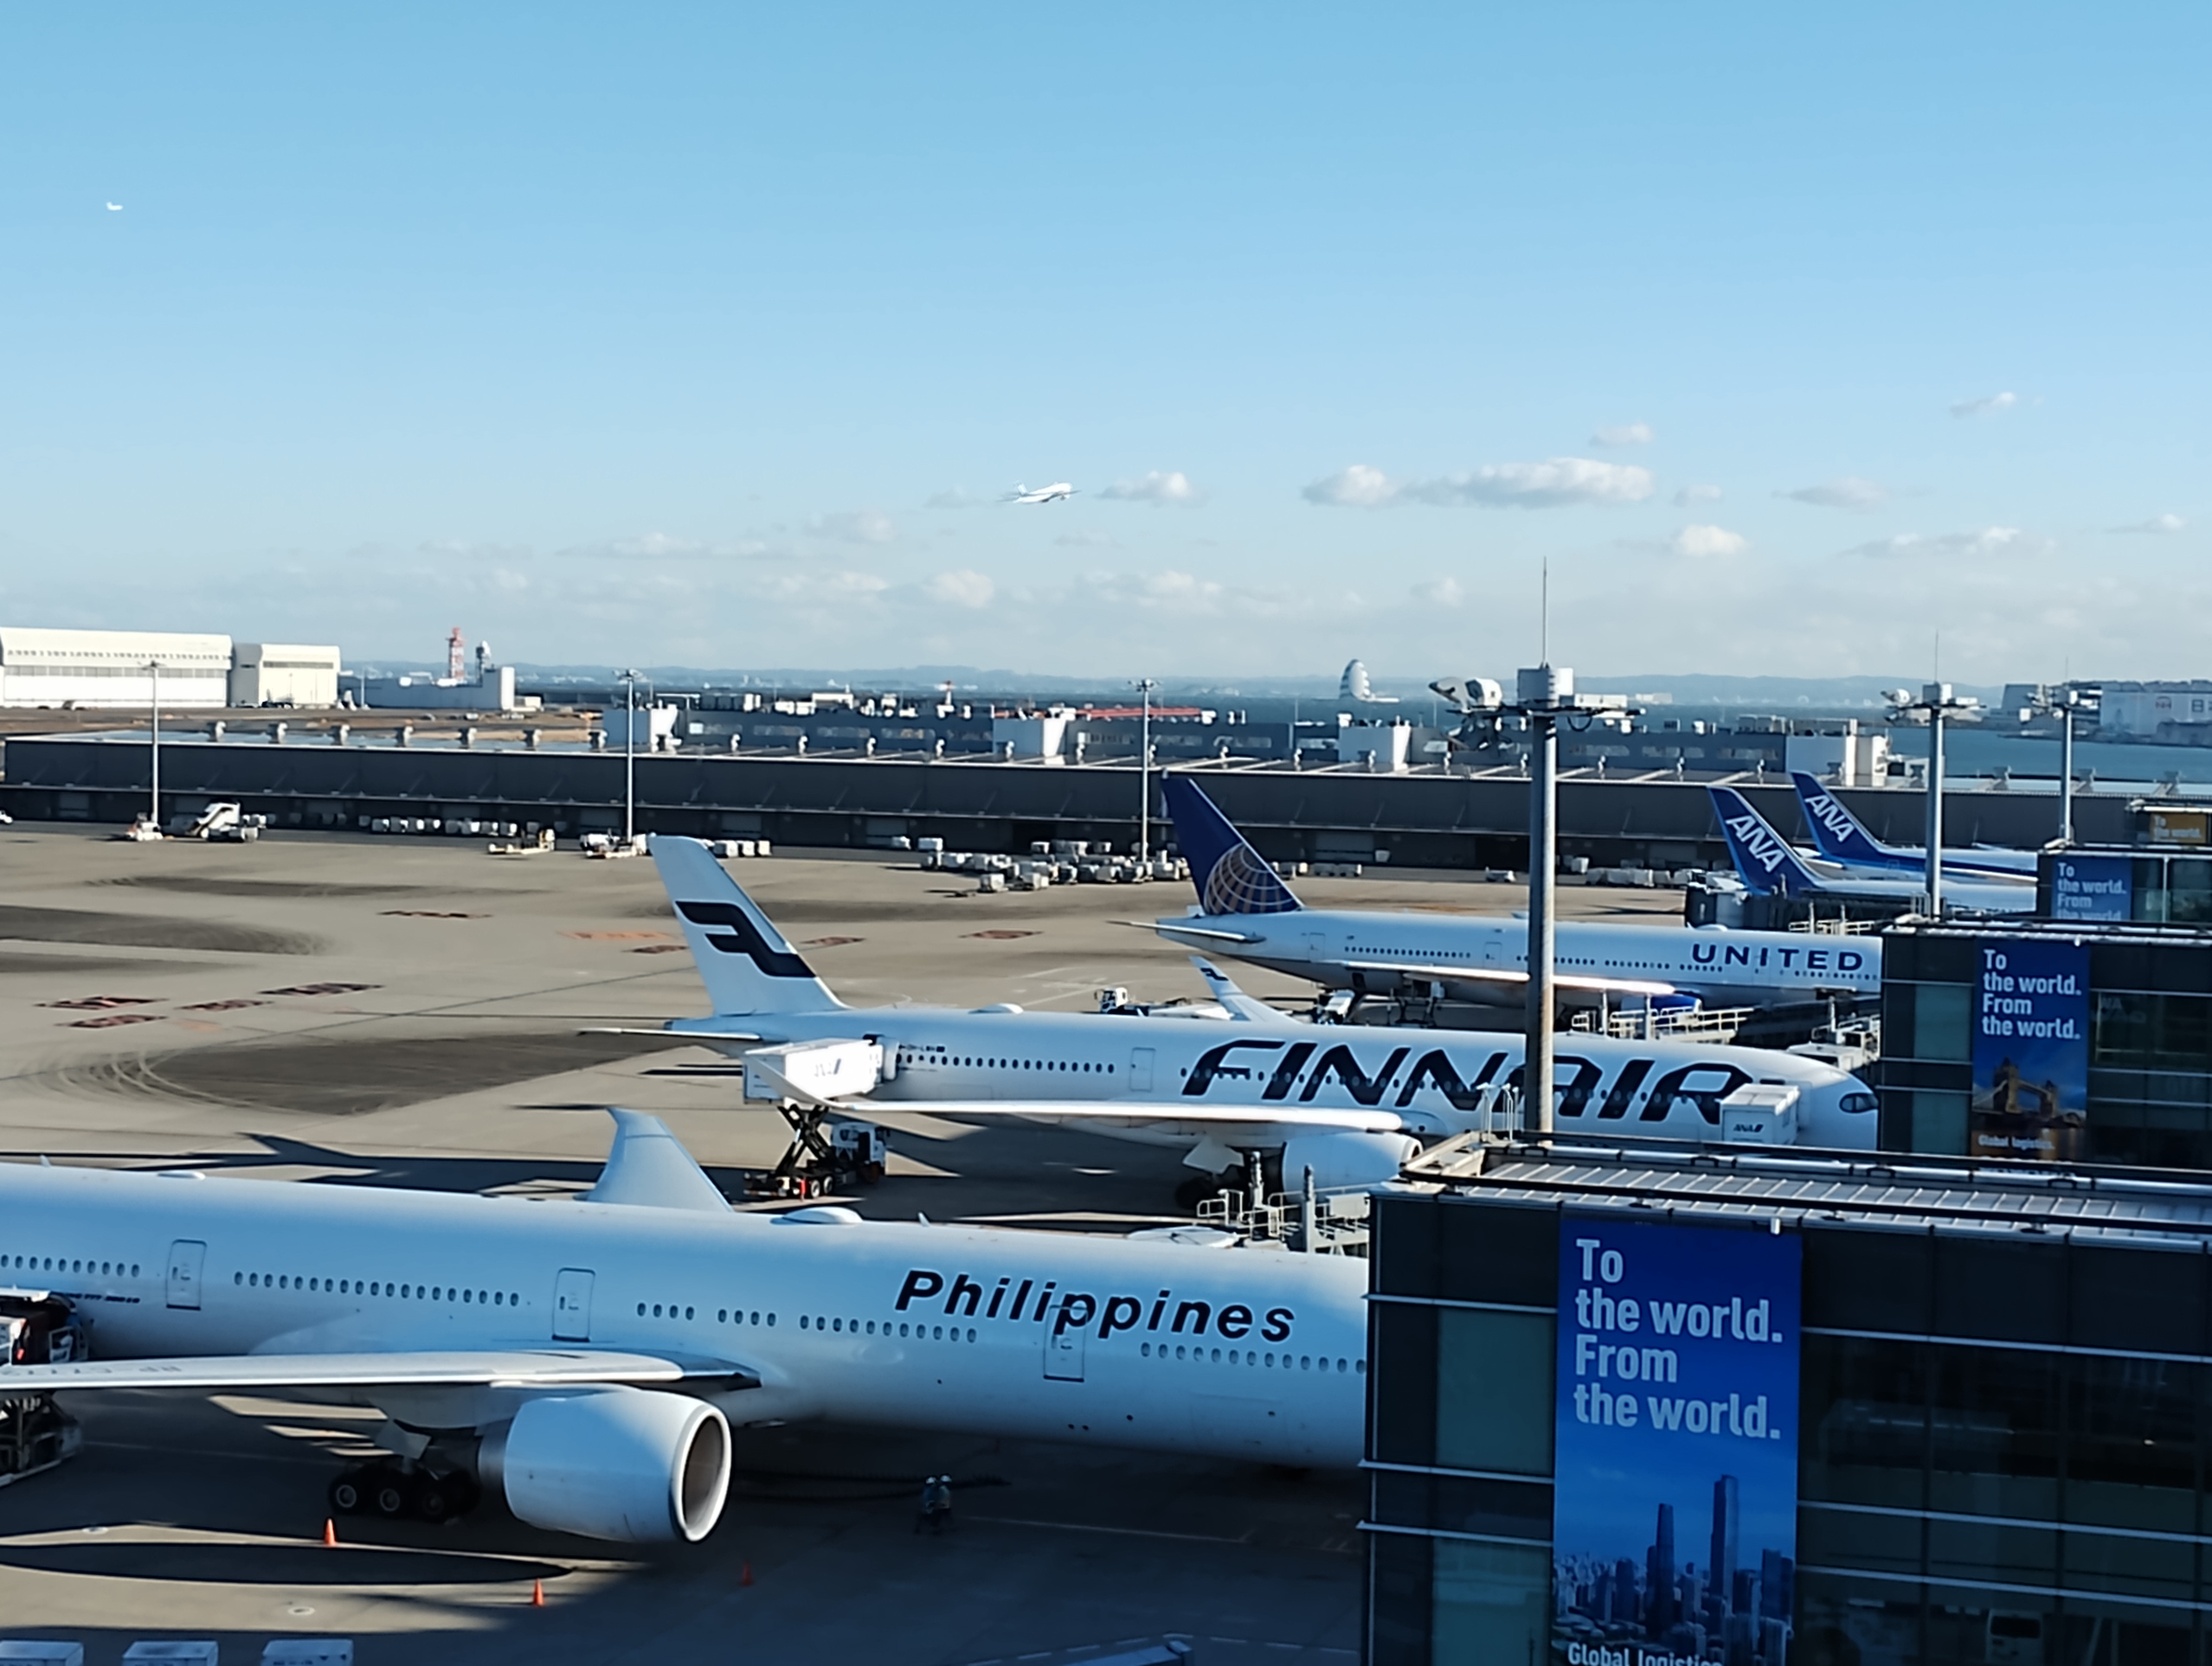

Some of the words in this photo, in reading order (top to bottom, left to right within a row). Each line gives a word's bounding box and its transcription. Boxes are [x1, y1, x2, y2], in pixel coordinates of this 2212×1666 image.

[1804, 794, 1855, 842] ANA
[1725, 815, 1785, 873] ANA
[2058, 862, 2075, 877] To
[2057, 878, 2080, 893] the
[2082, 879, 2127, 894] world.
[2057, 893, 2092, 908] From
[1692, 944, 1863, 971] UNITED
[1983, 949, 2007, 970] To
[1983, 971, 2015, 992] the
[2018, 974, 2082, 996] world.
[1983, 992, 2032, 1015] From
[1982, 1015, 2013, 1036] the
[2017, 1018, 2081, 1040] world.
[1181, 1038, 1754, 1125] FINNAIR
[1576, 1238, 1624, 1283] To
[895, 1269, 1296, 1343] Philippines
[1575, 1287, 1640, 1332] the
[1649, 1297, 1783, 1343] world.
[1576, 1334, 1678, 1383] From
[1573, 1382, 1638, 1427] the
[1648, 1393, 1781, 1440] world.
[1567, 1642, 1629, 1666] Global
